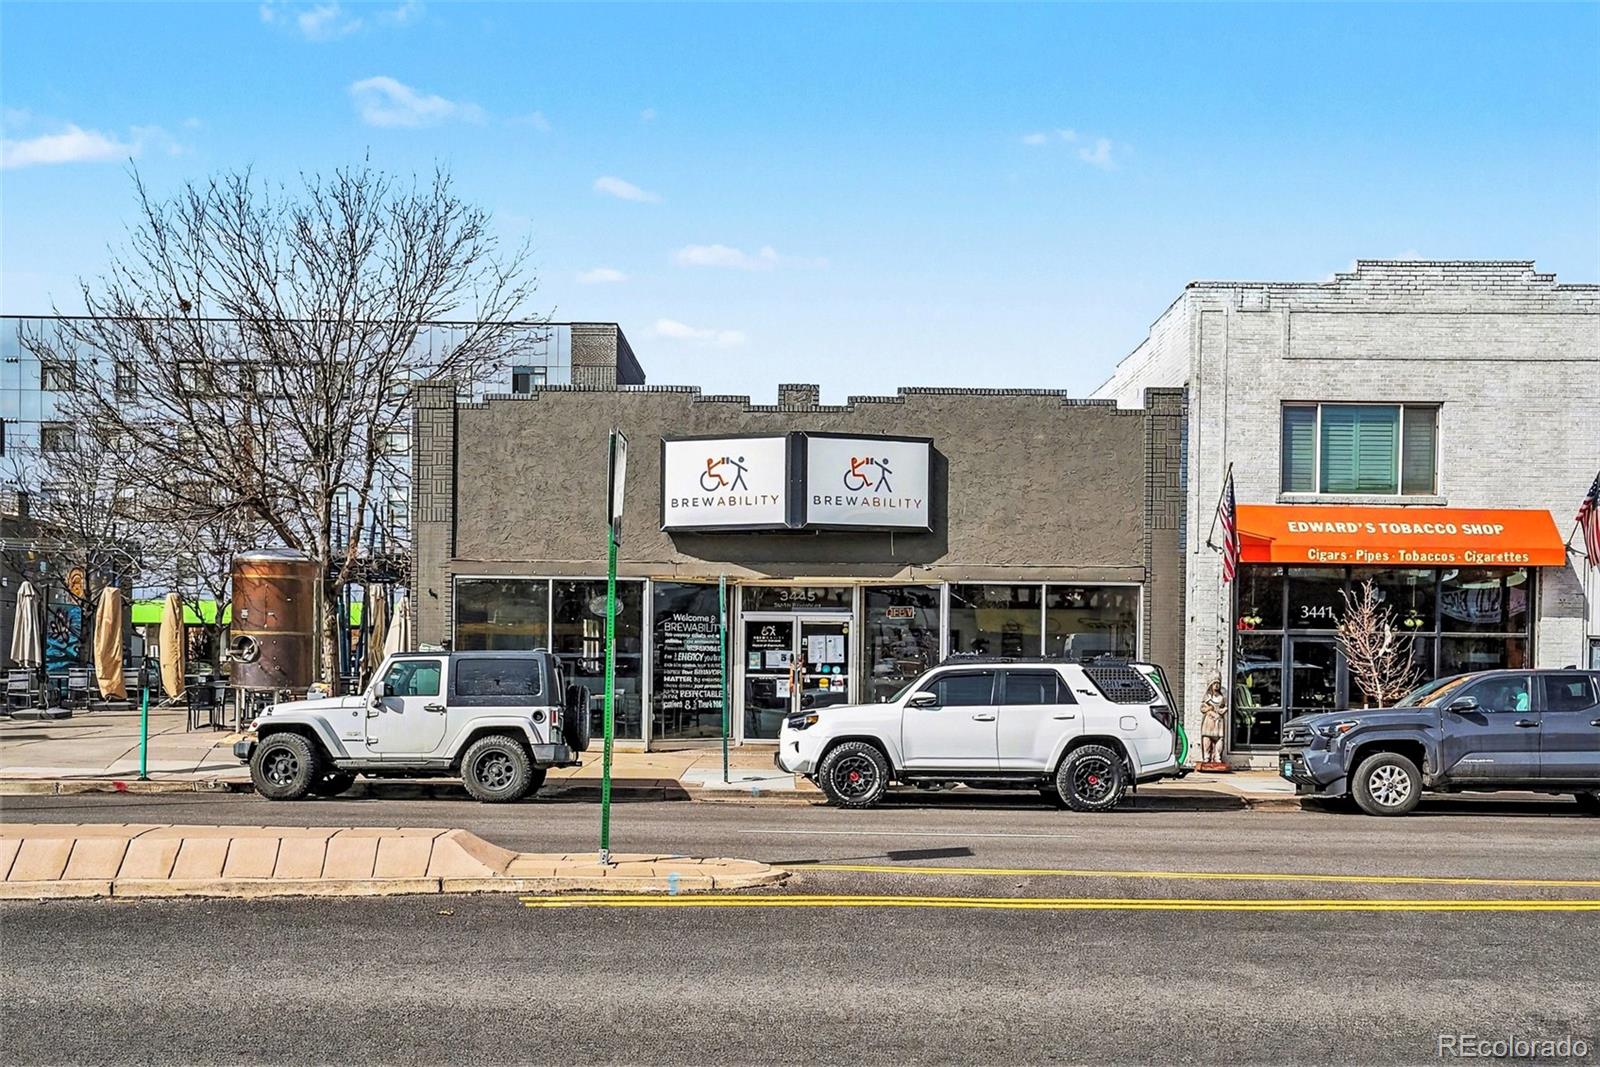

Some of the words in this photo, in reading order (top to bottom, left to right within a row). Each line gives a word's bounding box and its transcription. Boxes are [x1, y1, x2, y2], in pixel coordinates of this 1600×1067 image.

[671, 495, 779, 508] BREWABILITY
[813, 495, 922, 509] BREWABILITY
[1287, 521, 1376, 534] EDWARD'S
[1379, 522, 1457, 534] TOBACCO
[1461, 523, 1504, 535] SHOP
[1307, 548, 1347, 562] Cigars
[1356, 549, 1389, 563] Pipes
[1398, 550, 1455, 562] Tobaccos
[1464, 551, 1529, 564] Cigarettes
[780, 590, 816, 602] 3445
[673, 613, 710, 622] Welcome
[1300, 605, 1332, 618] 3441
